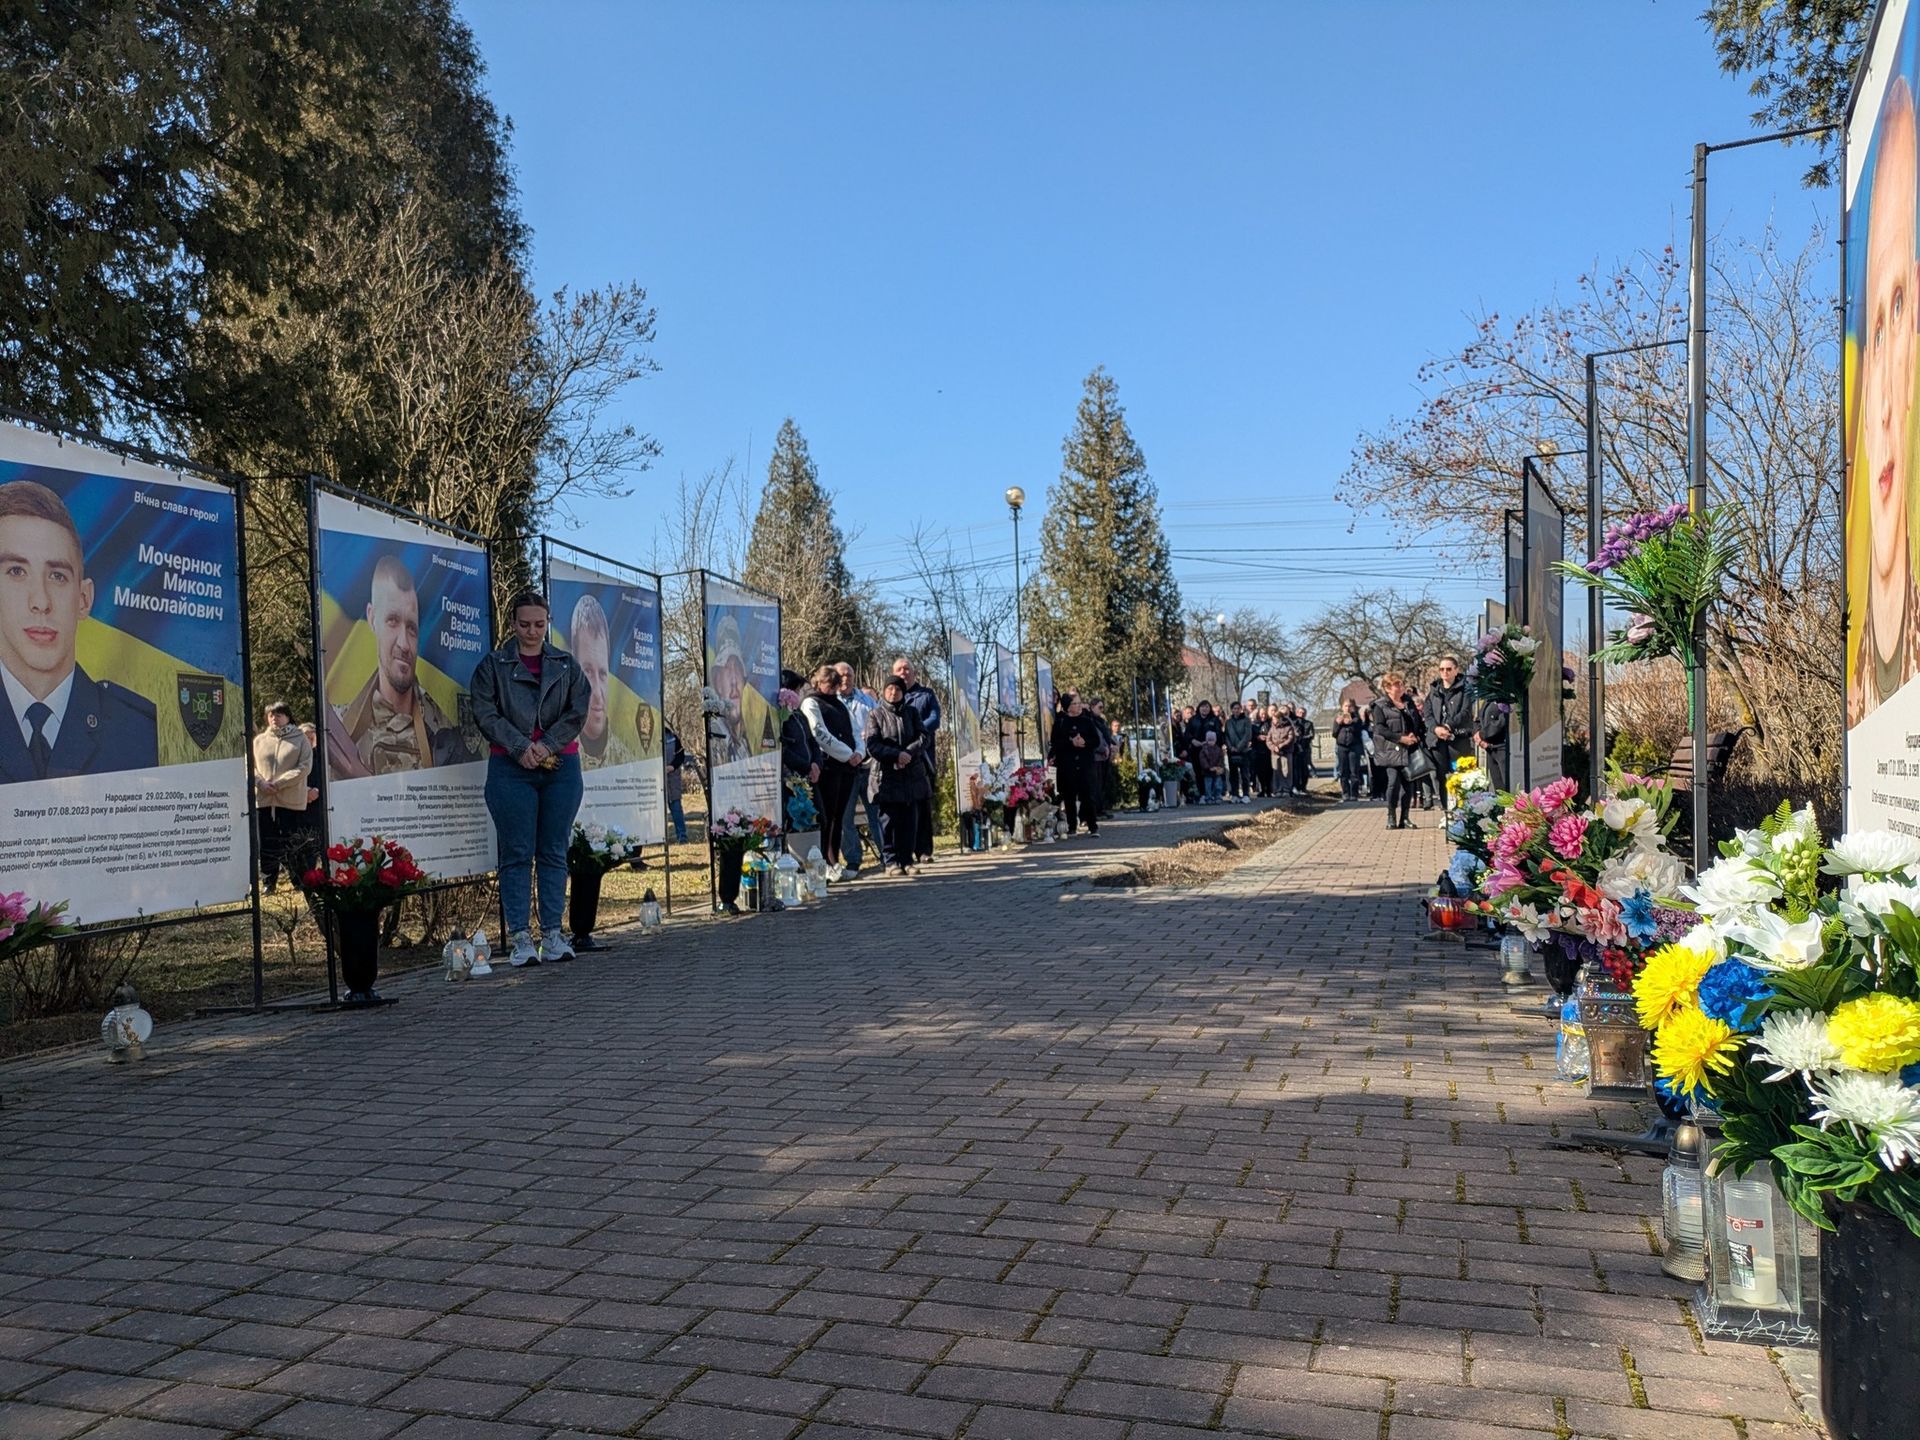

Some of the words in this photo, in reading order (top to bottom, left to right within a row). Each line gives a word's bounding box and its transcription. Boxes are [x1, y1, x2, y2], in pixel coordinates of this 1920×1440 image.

[134, 490, 160, 508] Вічна
[162, 500, 188, 515] слава
[190, 508, 219, 523] герою!
[138, 543, 222, 578] Мочернюк
[432, 553, 446, 567] Вічна
[447, 560, 462, 571] слава
[163, 571, 222, 600] Микола
[113, 585, 223, 621] Миколайович
[441, 595, 480, 621] Гончарук
[451, 616, 481, 635] Василь
[440, 631, 482, 653] Юрійович
[105, 793, 143, 802] Народився
[194, 790, 206, 799] селі
[13, 808, 46, 818] Загинув
[48, 806, 90, 816] 07.08.2023
[90, 806, 108, 816] року
[115, 804, 138, 815] районі
[139, 804, 175, 812] населеного
[177, 803, 198, 812] пункту
[174, 813, 206, 823] Донецької
[23, 838, 50, 846] солдат,
[51, 834, 87, 844] молодший
[88, 833, 118, 842] інспектор
[119, 830, 160, 840] прикордонної
[160, 828, 180, 837] служби
[36, 847, 82, 857] прикордонної
[84, 844, 108, 853] служби
[142, 840, 175, 848] інспекторів
[175, 837, 212, 846] прикордонної
[212, 834, 231, 843] служби
[32, 860, 58, 870] служби
[105, 865, 130, 874] чергове
[131, 862, 159, 871] військове
